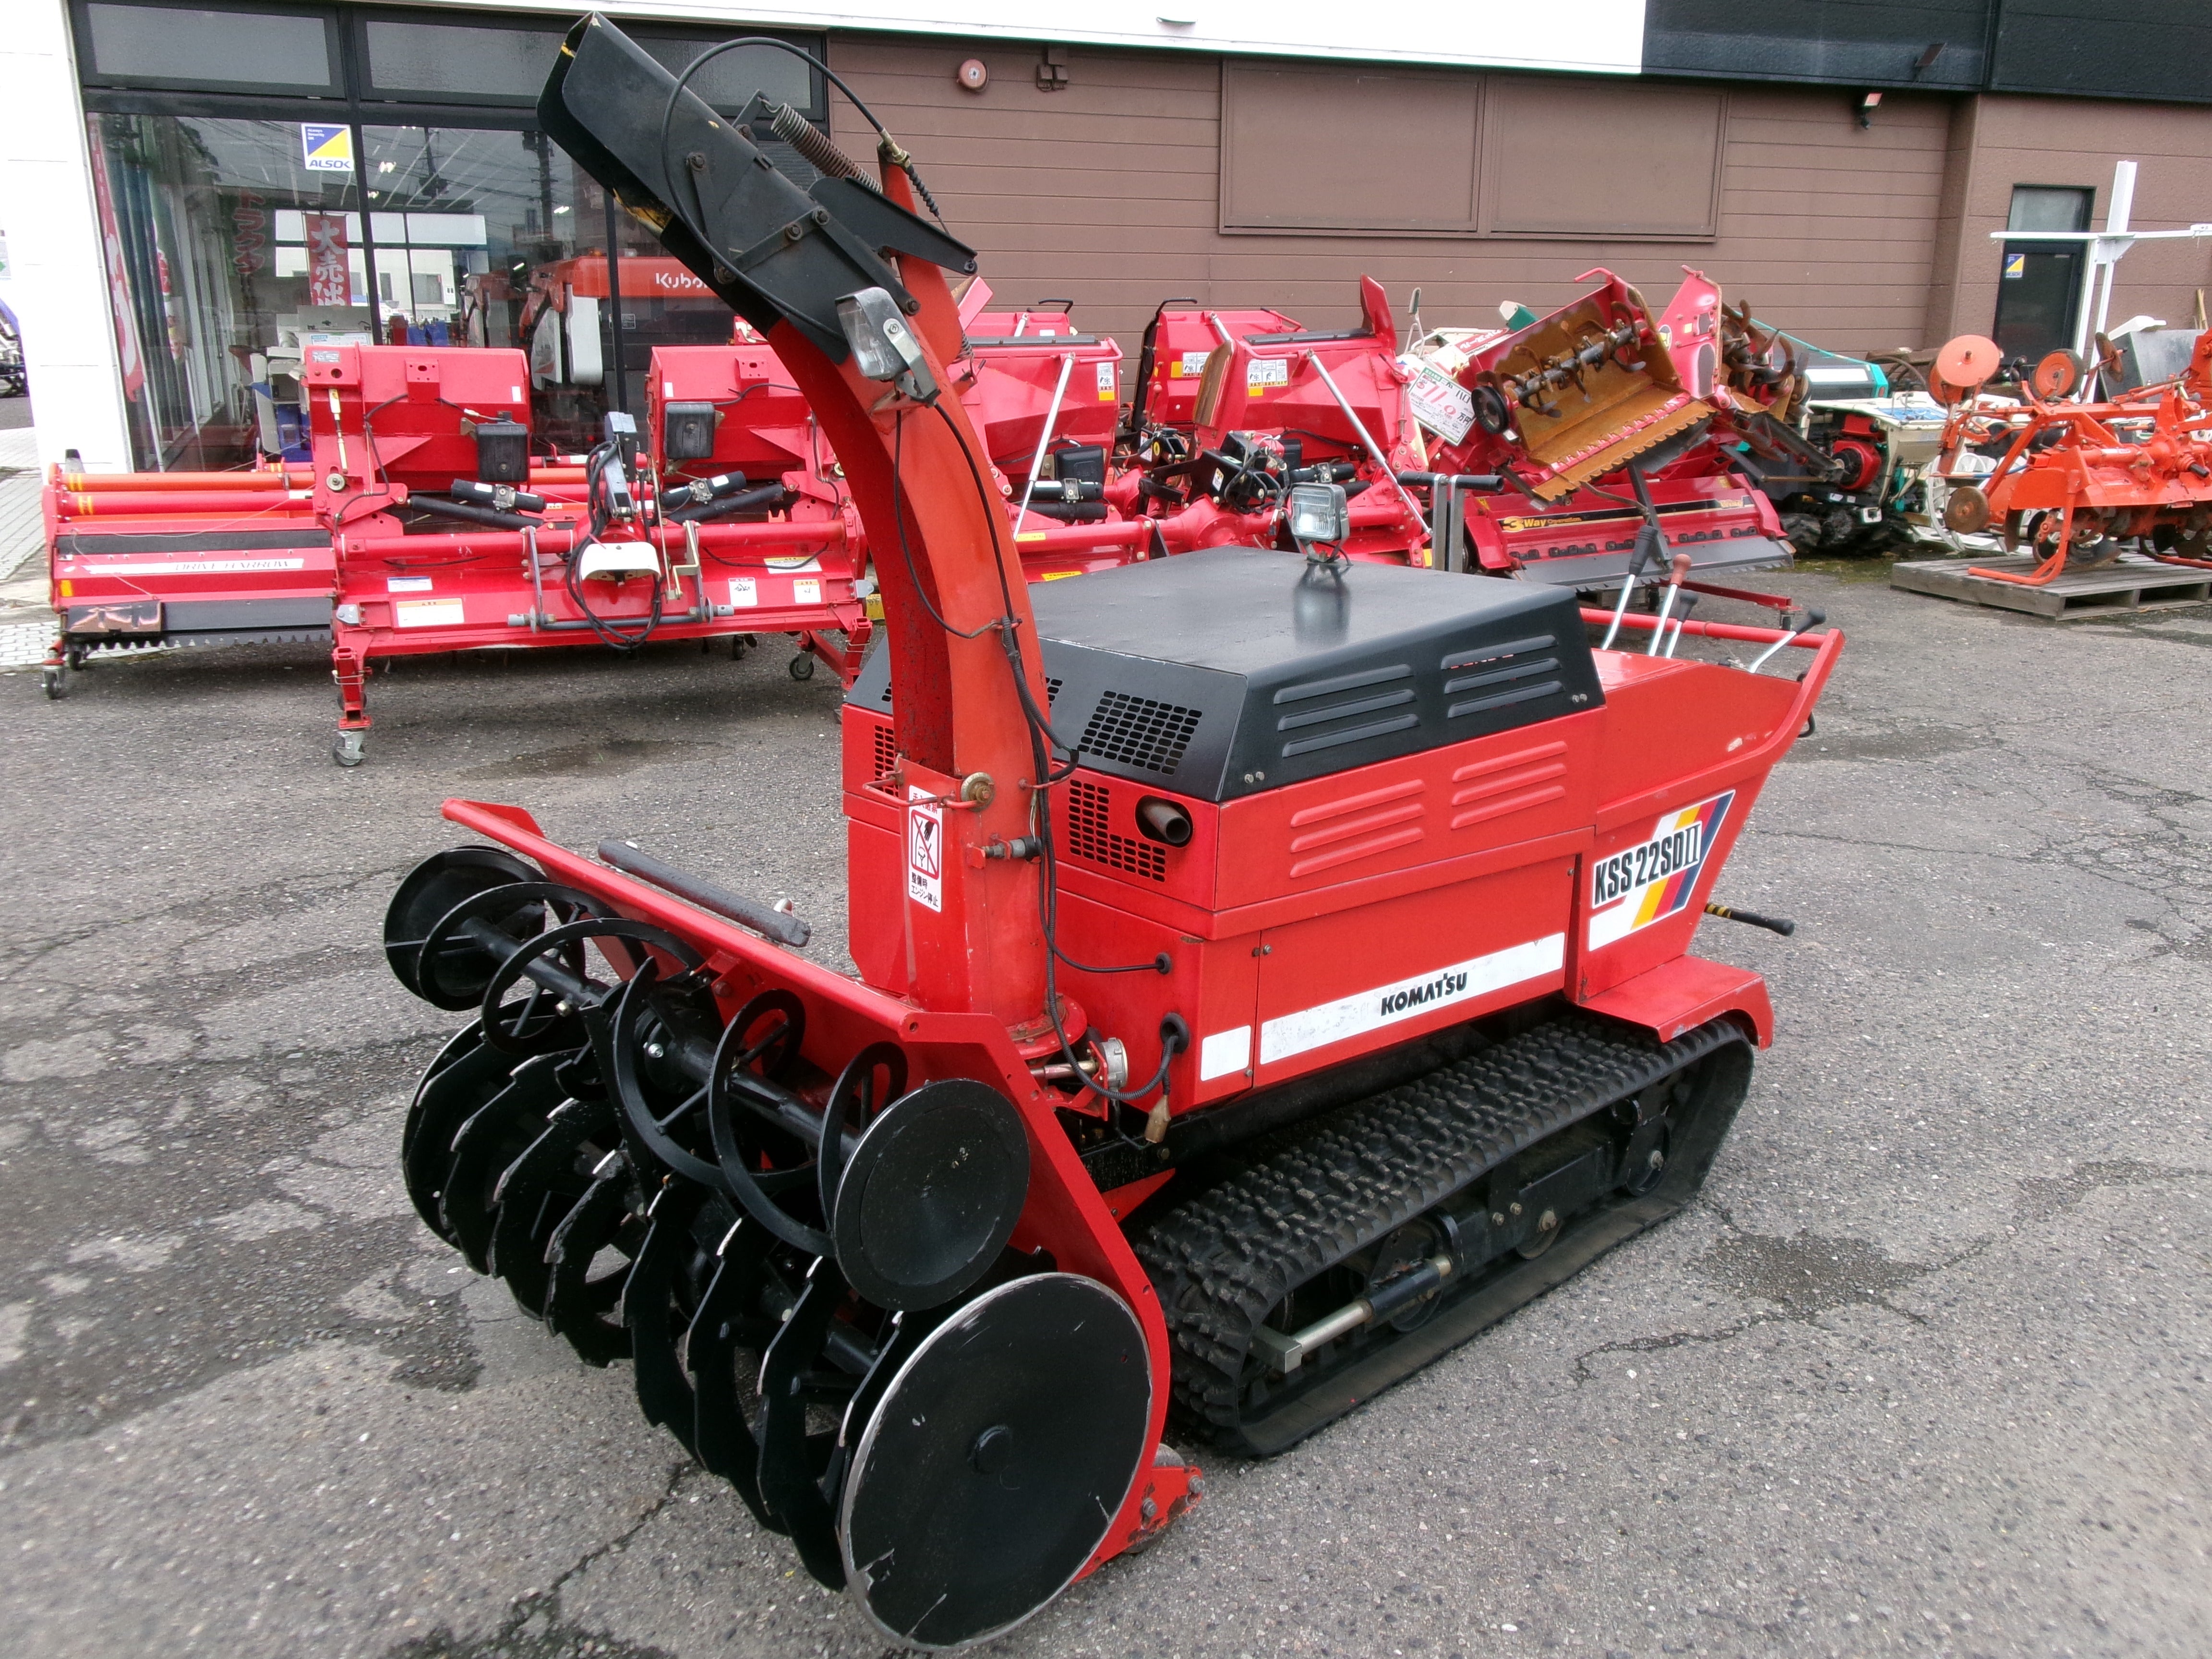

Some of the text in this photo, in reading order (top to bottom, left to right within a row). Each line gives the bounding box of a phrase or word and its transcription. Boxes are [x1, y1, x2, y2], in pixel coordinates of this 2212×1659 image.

[309, 159, 351, 168] ALSOK
[656, 273, 708, 289] Kubo
[911, 885, 938, 907] エンジン停止
[1381, 972, 1467, 1017] KOMATSU
